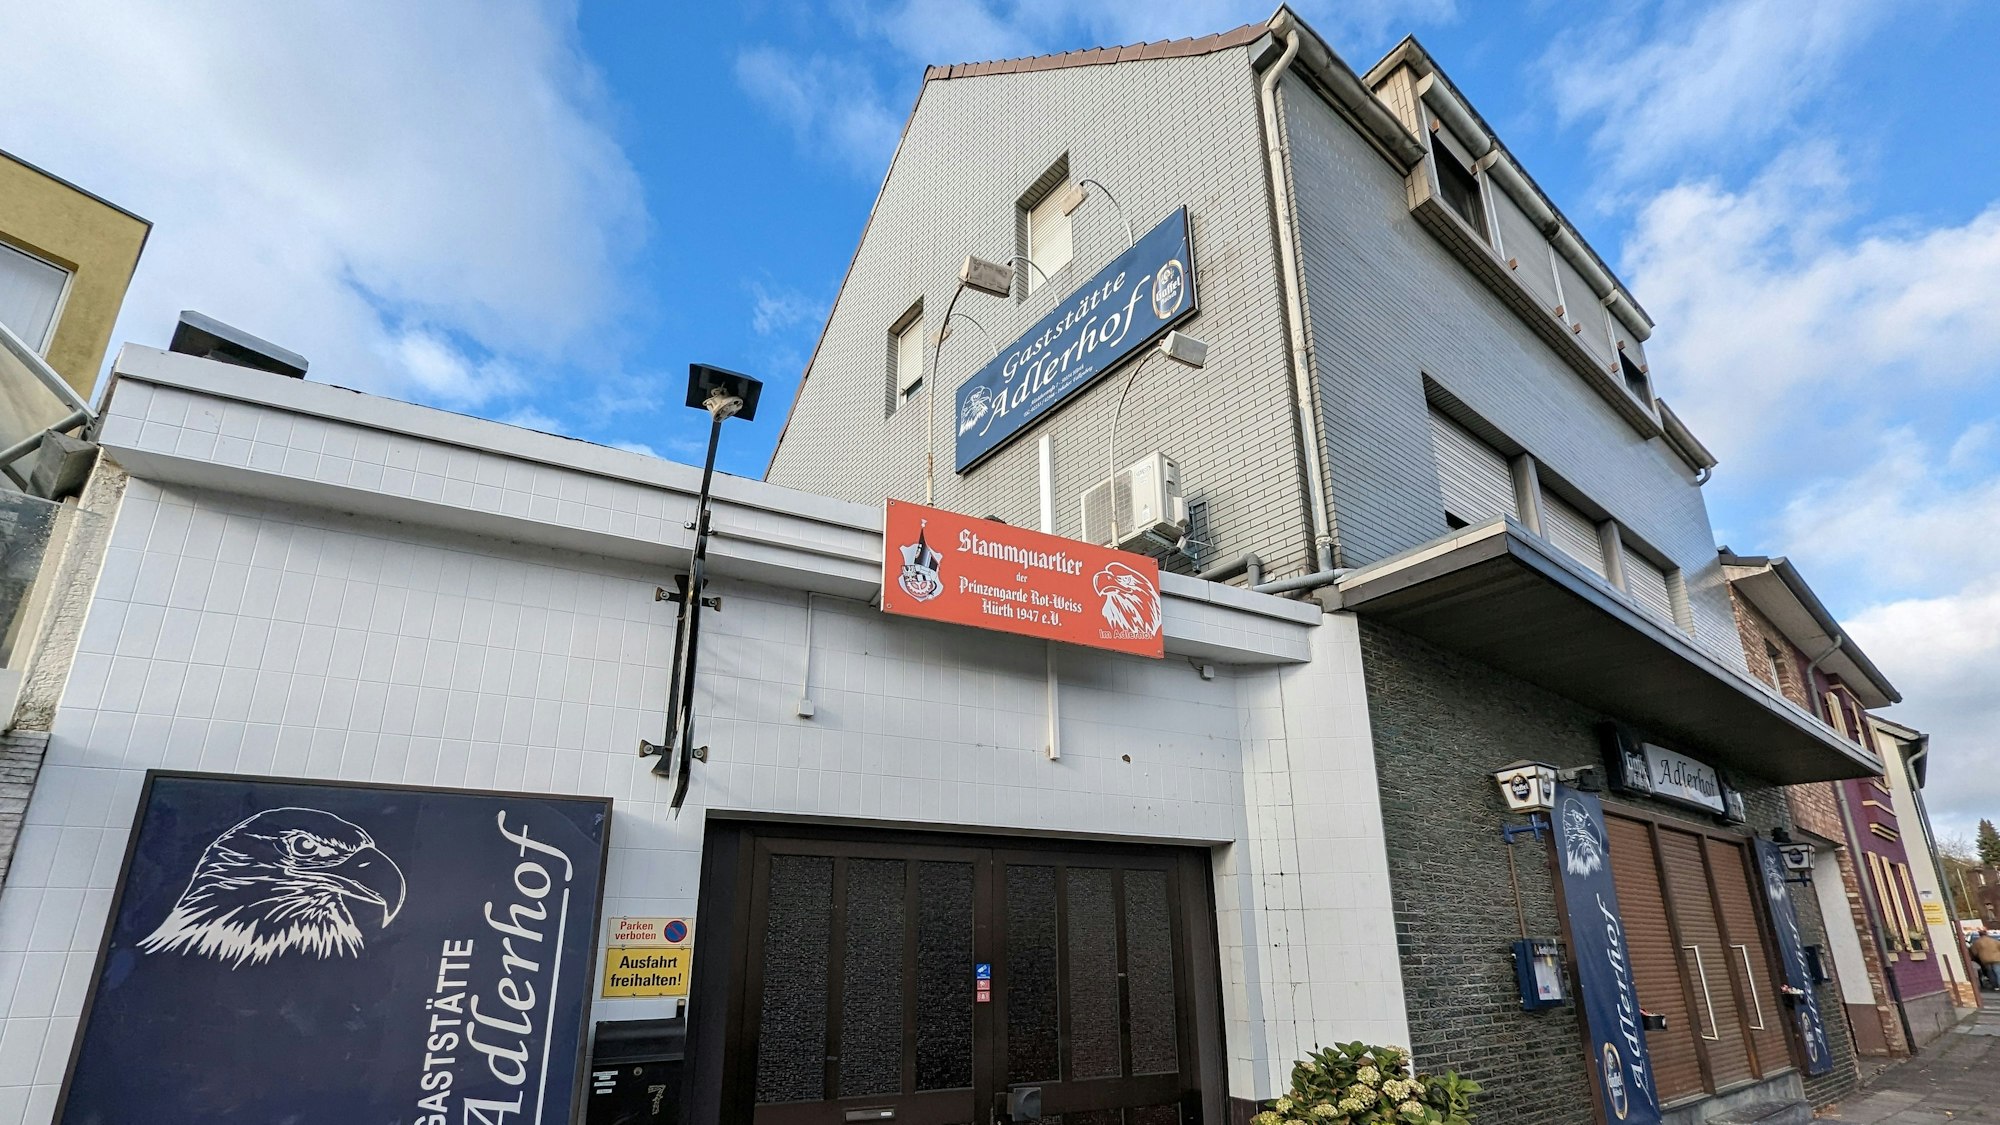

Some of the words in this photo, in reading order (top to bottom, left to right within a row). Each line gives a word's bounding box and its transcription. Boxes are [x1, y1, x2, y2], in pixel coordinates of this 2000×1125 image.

[1156, 276, 1181, 302] Gaffel
[1003, 271, 1126, 384] Gaststätte
[979, 274, 1150, 437] Adlerhof
[956, 528, 1083, 576] Stammquartier
[1015, 571, 1028, 583] der
[958, 575, 1028, 602] Prinzengarde
[1030, 589, 1082, 613] Rot-Weiss
[981, 598, 1014, 618] Hürth
[1016, 607, 1039, 623] 1947
[1658, 759, 1715, 797] Adlerhof
[615, 931, 656, 940] verboten
[620, 921, 653, 930] Parken
[619, 955, 678, 969] Ausfahrt
[610, 972, 682, 987] freihalten!
[1596, 893, 1653, 1105] Adlerhof
[647, 1084, 667, 1115] 7
